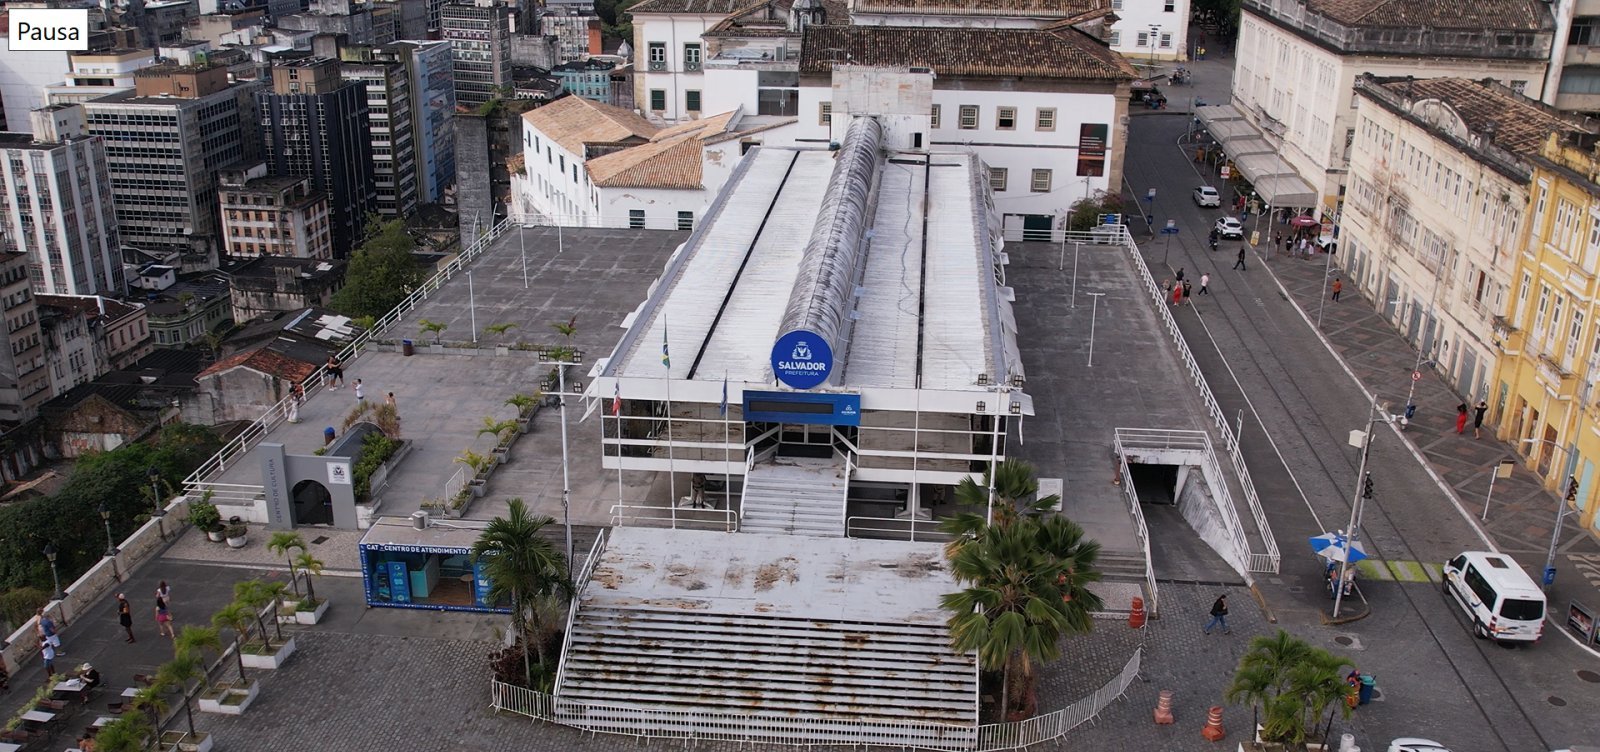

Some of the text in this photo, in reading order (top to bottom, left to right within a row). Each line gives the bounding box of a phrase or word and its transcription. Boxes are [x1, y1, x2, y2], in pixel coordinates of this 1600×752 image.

[778, 361, 826, 371] SALVADOR
[269, 459, 282, 523] CENTRO DE CULTURA
